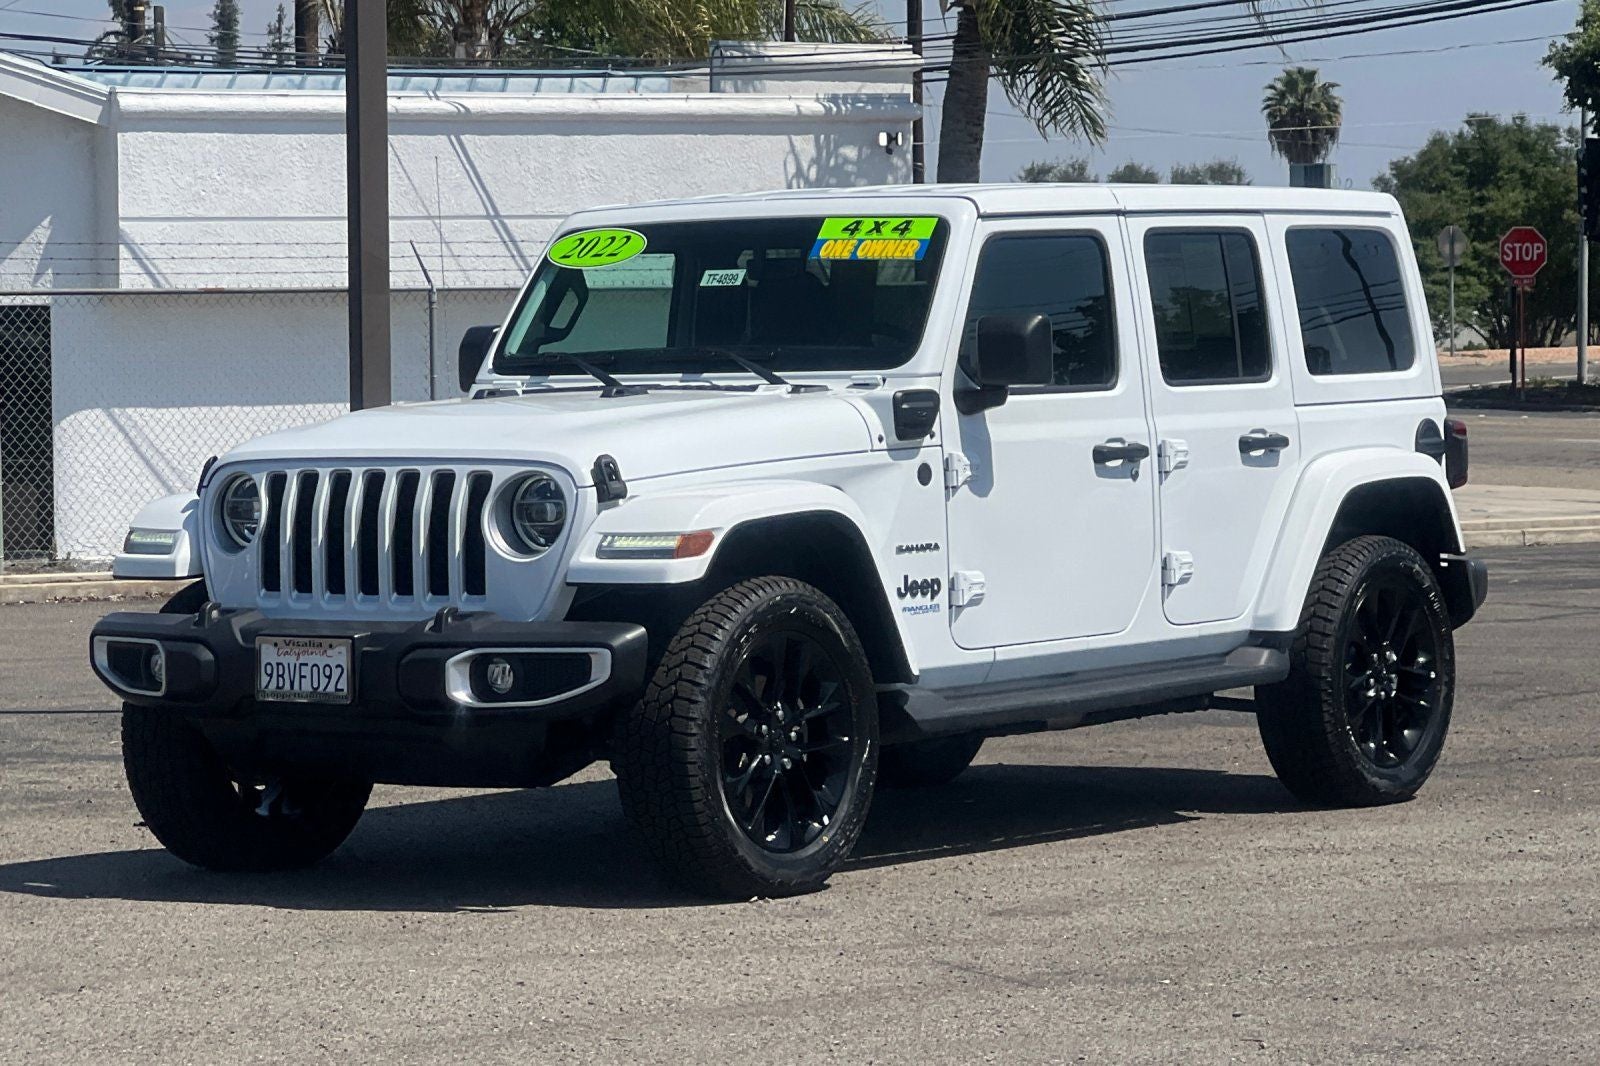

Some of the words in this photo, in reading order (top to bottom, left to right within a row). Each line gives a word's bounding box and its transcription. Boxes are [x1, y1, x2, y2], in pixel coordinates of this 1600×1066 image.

[558, 235, 632, 259] 2022
[820, 240, 858, 259] ONE
[857, 240, 921, 259] OWNER
[1503, 243, 1544, 261] STOP
[706, 273, 739, 285] TF4899
[896, 542, 940, 555] SAHARA
[897, 574, 941, 602] Jeep
[283, 639, 323, 648] Visalia
[276, 647, 333, 661] California
[263, 662, 345, 692] 9BVF092
